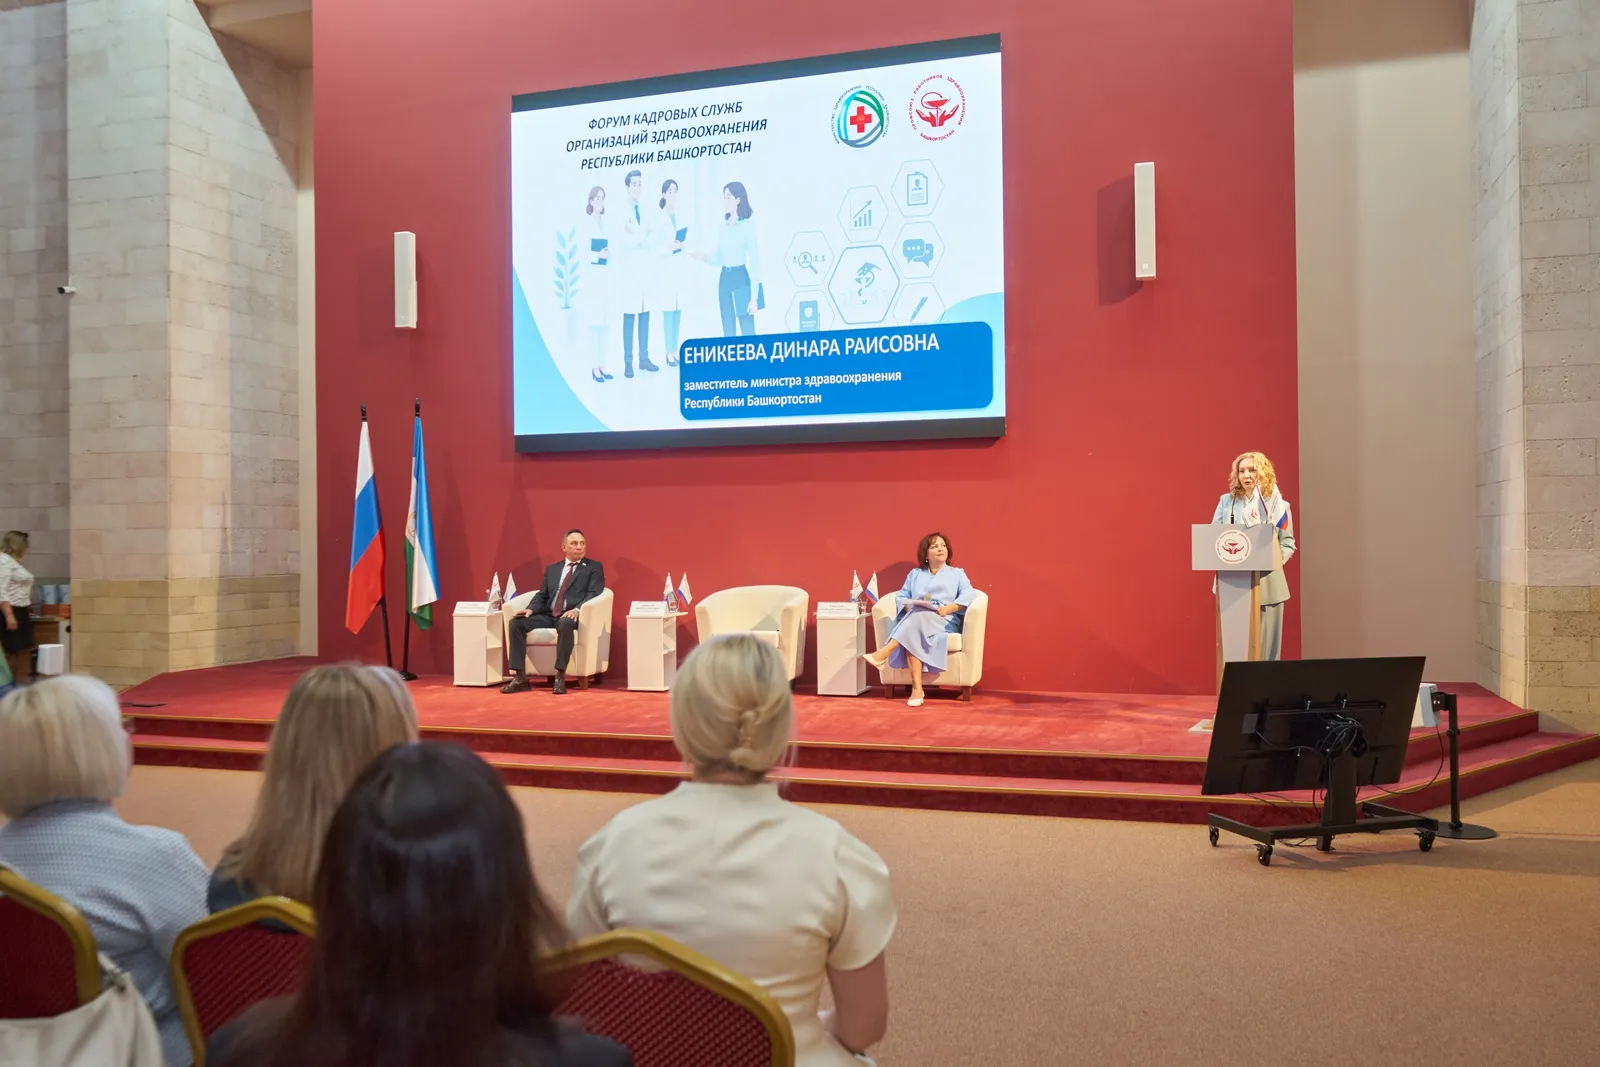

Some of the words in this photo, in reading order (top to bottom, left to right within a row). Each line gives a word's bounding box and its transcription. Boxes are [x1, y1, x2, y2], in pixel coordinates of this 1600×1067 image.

[588, 115, 631, 130] ФОРУМ
[633, 106, 699, 126] КАДРОВЫХ
[701, 101, 743, 117] СЛУЖБ
[566, 130, 649, 152] ОРГАНИЗАЦИЙ
[650, 118, 768, 144] ЗДРАВООХРАНЕНИЯ
[580, 152, 654, 170] РЕСПУБЛИКИ
[656, 141, 752, 162] БАШКОРТОСТАН
[684, 343, 767, 364] ЕНИКЕЕВА
[770, 338, 841, 363] ДИНАРА
[845, 332, 940, 356] РАИСОВНА
[684, 378, 748, 391] заместитель
[750, 376, 802, 389] министра
[804, 371, 902, 387] здравоохранения
[684, 396, 744, 411] Республики
[747, 394, 822, 407] Башкортостан
